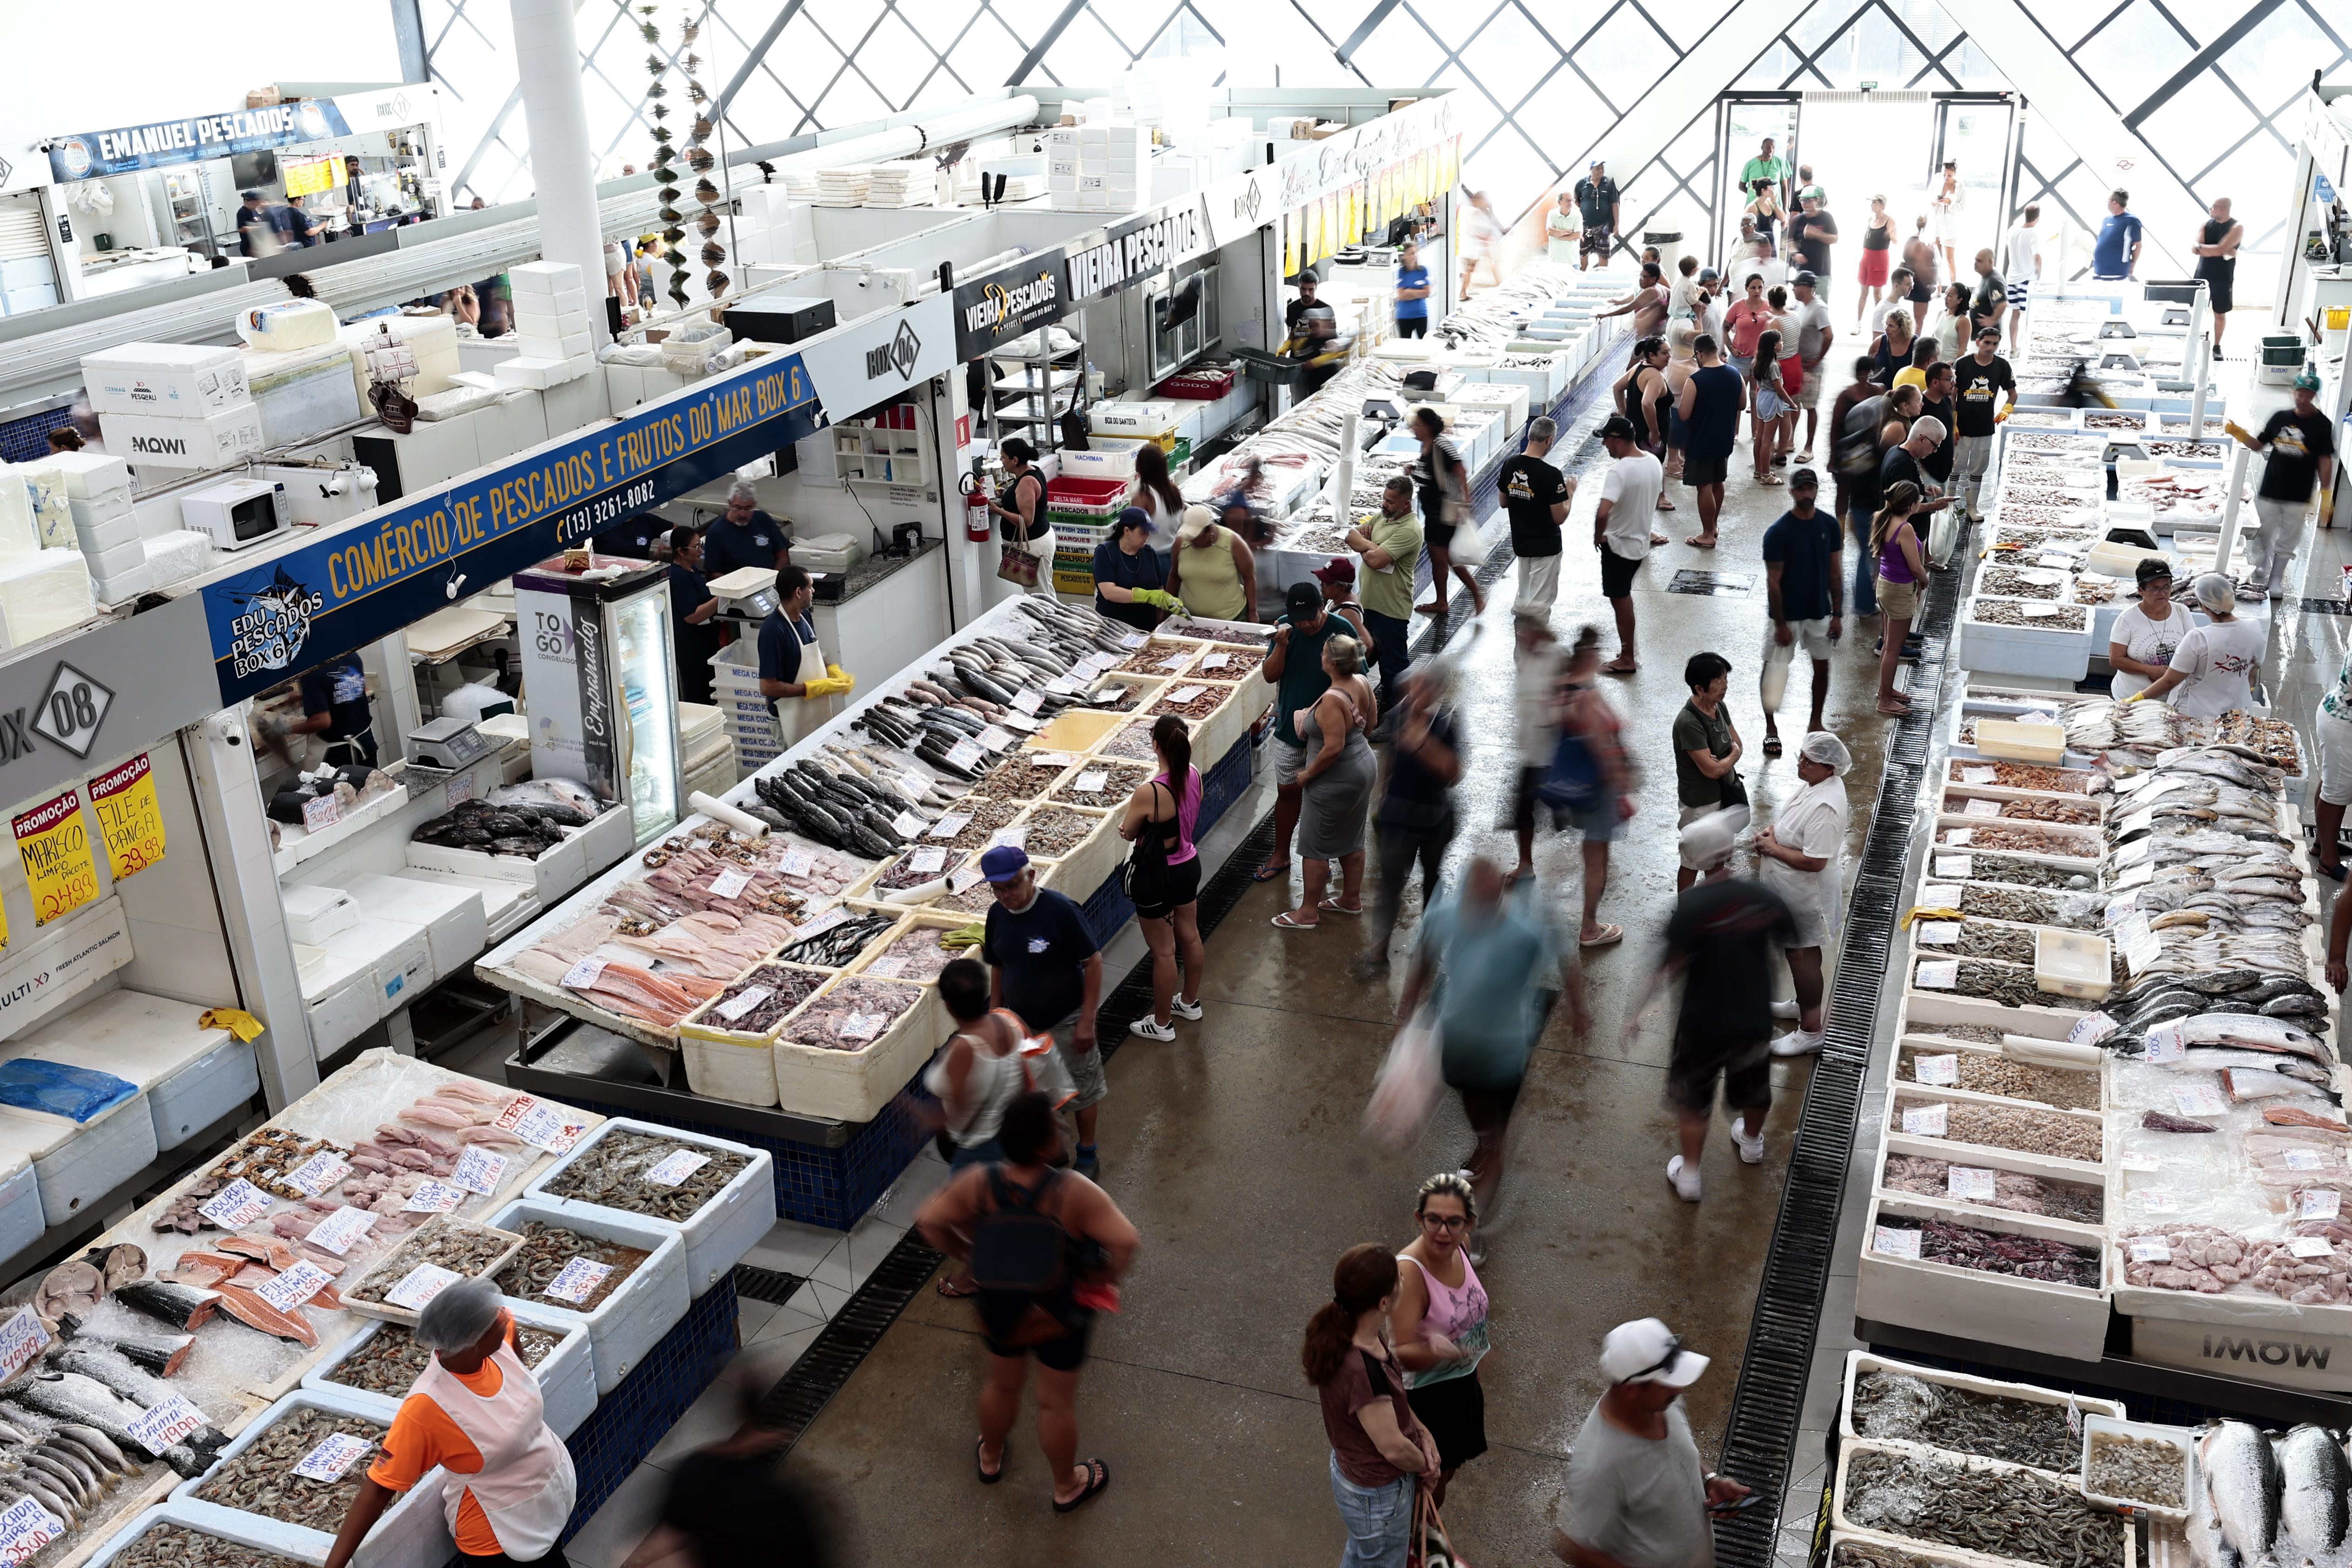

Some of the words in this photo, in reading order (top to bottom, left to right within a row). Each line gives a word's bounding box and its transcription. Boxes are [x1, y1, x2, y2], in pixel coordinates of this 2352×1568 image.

[377, 103, 392, 117] BOX
[98, 122, 196, 160] EMANUEL
[196, 107, 294, 144] PESCADOS
[1234, 194, 1247, 219] BOX
[1064, 238, 1124, 301] VIEIRA
[1124, 209, 1200, 278] PESCADOS
[964, 296, 1001, 333] VIEIRA
[1004, 275, 1055, 318] PESCADOS
[1022, 311, 1037, 323] FRUTOS
[866, 343, 892, 380] BOX
[898, 335, 914, 366] 06
[1258, 362, 1271, 371] 2026
[132, 436, 186, 455] MOWI
[328, 510, 450, 599] COMÉRCIO
[454, 502, 485, 546] DE
[493, 449, 595, 531] PESCADOS
[601, 443, 613, 482] E
[617, 416, 685, 472] FRUTOS
[689, 402, 712, 444] DO
[716, 387, 751, 433] MAR
[757, 372, 785, 417] BOX
[791, 365, 801, 401] 6
[1508, 488, 1531, 498] SANTISTA
[566, 509, 592, 540] (13)
[595, 479, 655, 525] 3261-8082
[1054, 554, 1085, 562] BACALHAU
[230, 591, 323, 660] PESCADOS
[231, 608, 267, 637] EDU
[535, 611, 560, 632] TO
[536, 634, 562, 655] GO
[538, 653, 578, 665] CONGELADOS
[235, 653, 270, 679] BOX
[271, 642, 284, 669] 6
[732, 669, 750, 678] MEGA
[575, 616, 607, 737] Empanados
[737, 702, 749, 710] MEGA
[749, 703, 761, 712] CUBO
[0, 706, 37, 767] OX
[51, 681, 97, 737] 08
[742, 749, 754, 757] MEGA
[754, 750, 766, 758] CUBO
[743, 760, 760, 768] MEGA
[92, 757, 148, 799] PROMOÇÃO
[16, 794, 77, 838] PROMOÇÃO
[96, 788, 136, 838] FILÉ
[140, 795, 151, 810] DE
[108, 812, 156, 854] PANGA
[20, 825, 83, 876] MARISCO
[119, 836, 161, 877] 39,99
[37, 861, 68, 882] LIMPO
[61, 860, 89, 880] PACOTE
[42, 873, 94, 920] 24,99
[55, 959, 73, 973] FRESH
[73, 943, 98, 962] ATLANTIC
[98, 930, 121, 947] SALMON
[494, 1095, 534, 1129] OFERTA
[538, 1108, 547, 1118] DE
[529, 1115, 563, 1145] PANGA
[1981, 1171, 1992, 1190] POLVO
[204, 1179, 251, 1217] DOURADO
[1910, 1231, 1918, 1252] LULA
[0, 1314, 27, 1344] ECA
[2202, 1333, 2332, 1370] MOWI
